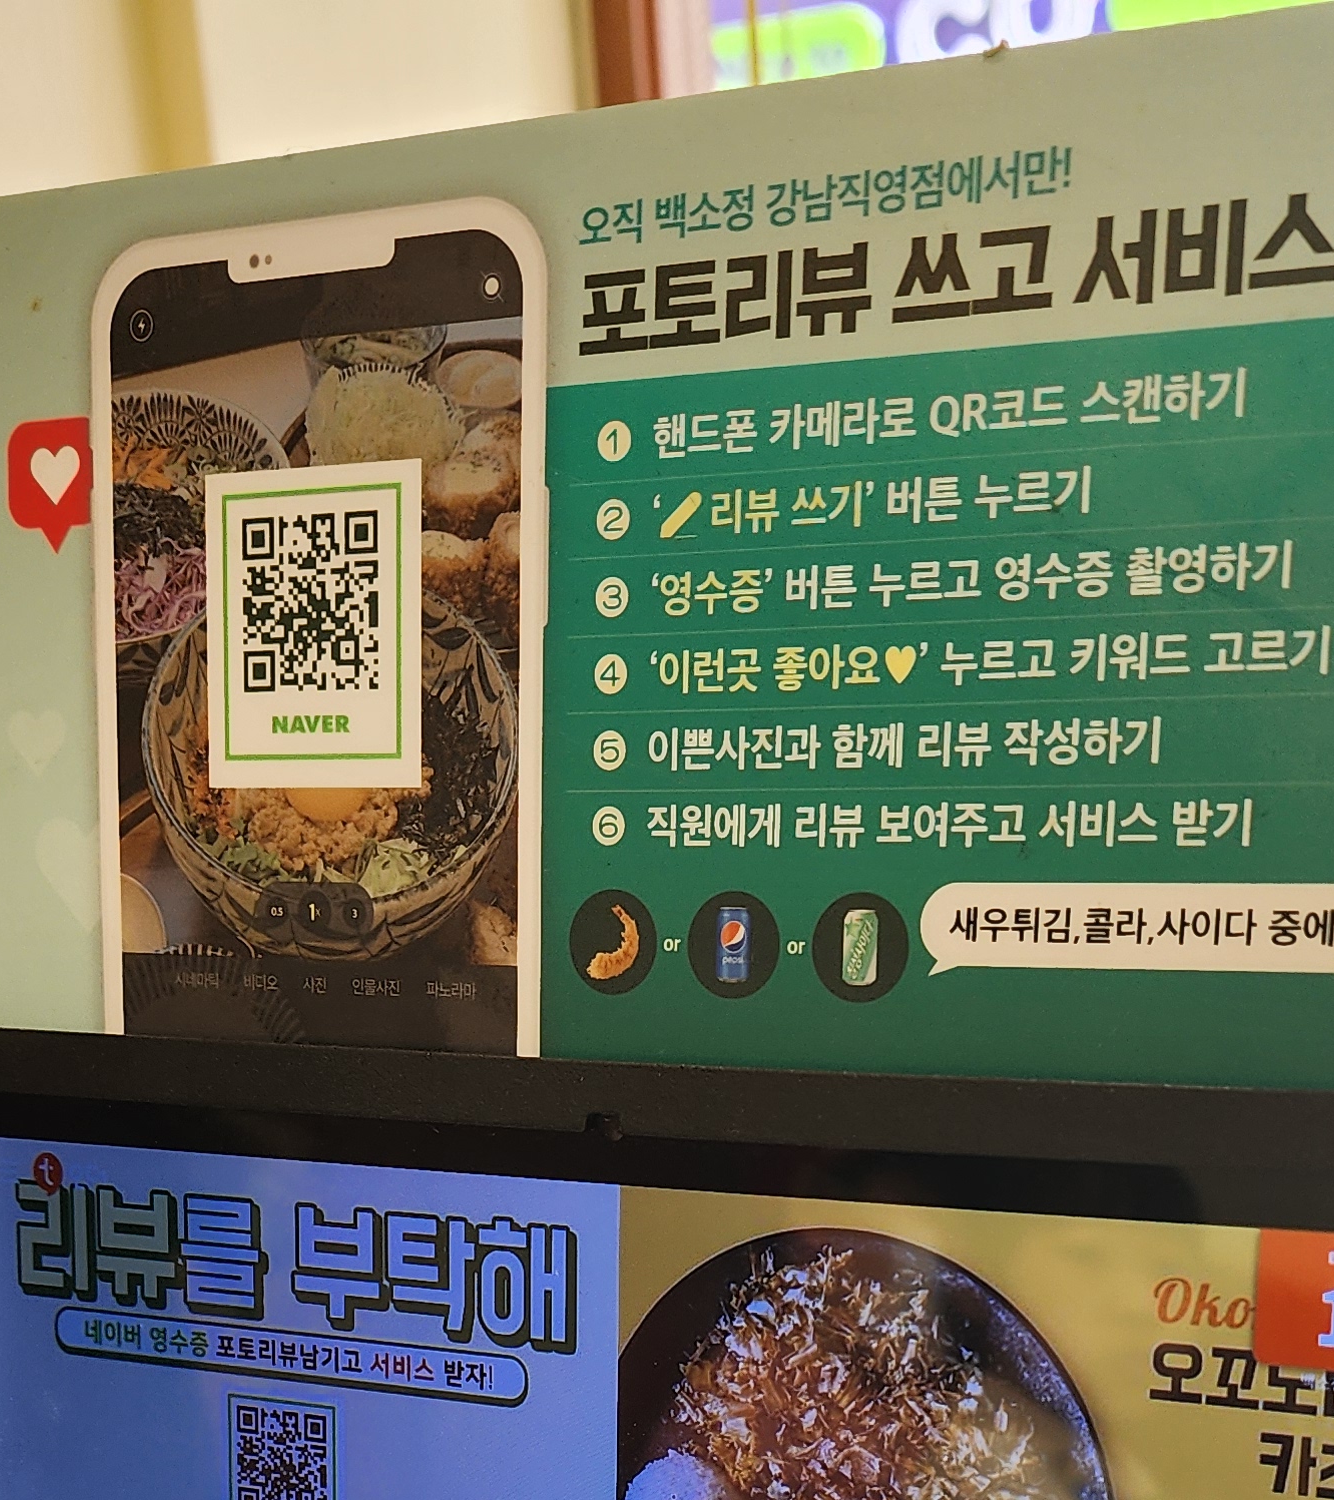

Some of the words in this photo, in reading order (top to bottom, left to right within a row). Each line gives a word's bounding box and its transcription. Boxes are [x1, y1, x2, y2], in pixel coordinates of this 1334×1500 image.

[578, 198, 644, 246] 오직
[654, 184, 755, 239] 백소정
[766, 145, 1073, 228] 강남직영점에서만!
[578, 241, 872, 356] 포토리뷰
[891, 225, 1054, 324] 쓰고
[653, 409, 758, 459] 핸드폰
[769, 397, 916, 450] 카메라로
[928, 384, 1068, 437] QR코드
[1080, 366, 1247, 424] 스캔하기
[711, 488, 779, 534] 리뷰
[886, 476, 962, 523] 버튼
[974, 465, 1091, 519] 누르기
[785, 564, 857, 610] 버튼
[868, 559, 982, 608] 누르고
[995, 551, 1113, 602] 영수증
[1126, 539, 1293, 596] 촬영하기
[940, 638, 1056, 686] 누르고
[1069, 631, 1191, 681] 키워드
[1204, 624, 1331, 675] 고르기
[272, 714, 350, 734] NAVER
[648, 723, 821, 772] 이쁜사진과
[832, 722, 904, 769] 함께
[917, 721, 991, 768] 리뷰
[1004, 715, 1162, 767] 작성하기
[646, 803, 781, 848] 직원에게
[795, 803, 865, 848] 리뷰
[876, 801, 1027, 849] 보여주고
[1038, 799, 1158, 848] 서비스
[1172, 798, 1253, 848] 받기
[270, 906, 284, 918] 0.5
[351, 908, 359, 919] 3
[949, 906, 1258, 946] 새우튀김,콜라,사이다
[663, 937, 681, 952] or
[787, 940, 806, 955] or
[244, 974, 279, 991] 비디오
[303, 976, 327, 994] 사진
[352, 979, 401, 997] 인물사진
[425, 981, 478, 1000] 파노라마
[17, 1178, 269, 1320] 리뷰를
[291, 1203, 578, 1355] 부탁해
[1153, 1276, 1255, 1331] Oko
[84, 1318, 141, 1350] 네이버
[149, 1325, 209, 1359] 영수증
[215, 1333, 363, 1375] 포토리뷰남기고
[370, 1352, 435, 1383] 서비스
[443, 1360, 495, 1391] 받자!
